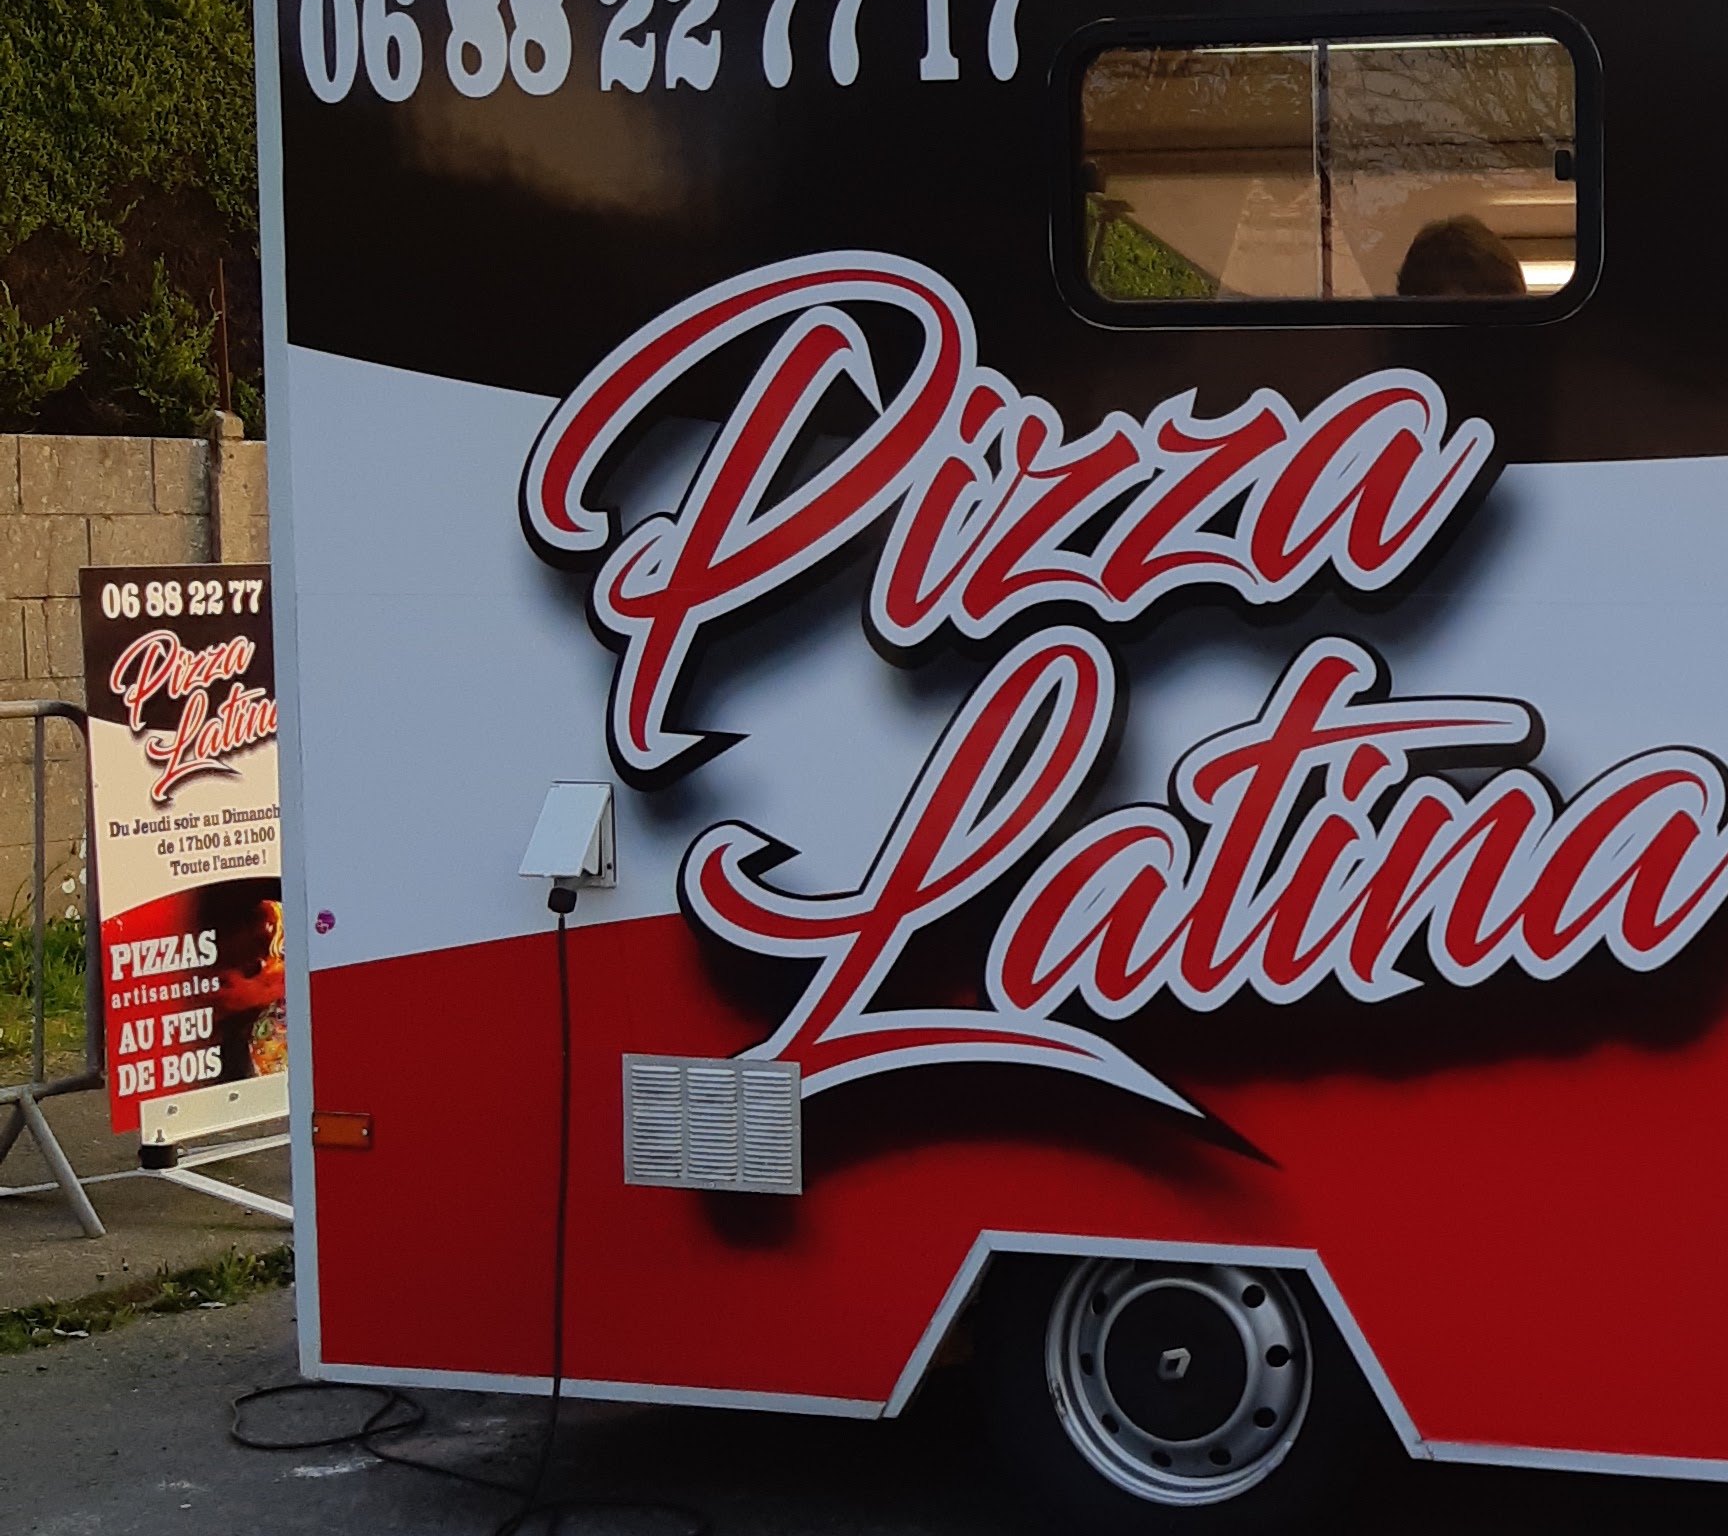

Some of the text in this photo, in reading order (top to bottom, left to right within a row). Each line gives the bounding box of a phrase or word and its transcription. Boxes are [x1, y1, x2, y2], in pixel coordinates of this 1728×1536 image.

[519, 248, 1496, 770] Pizza
[102, 579, 263, 619] 06 88 22 77
[110, 629, 256, 732] Pizza
[109, 803, 281, 838] Du Jeudi soir au Dimanch
[157, 826, 275, 855] de 17h00 à 21h00
[169, 860, 211, 877] Toute
[110, 928, 218, 981] PIZZAS
[111, 975, 221, 1009] artisanales
[118, 1007, 213, 1056] AU FEU
[117, 1045, 222, 1097] DE BOIS
